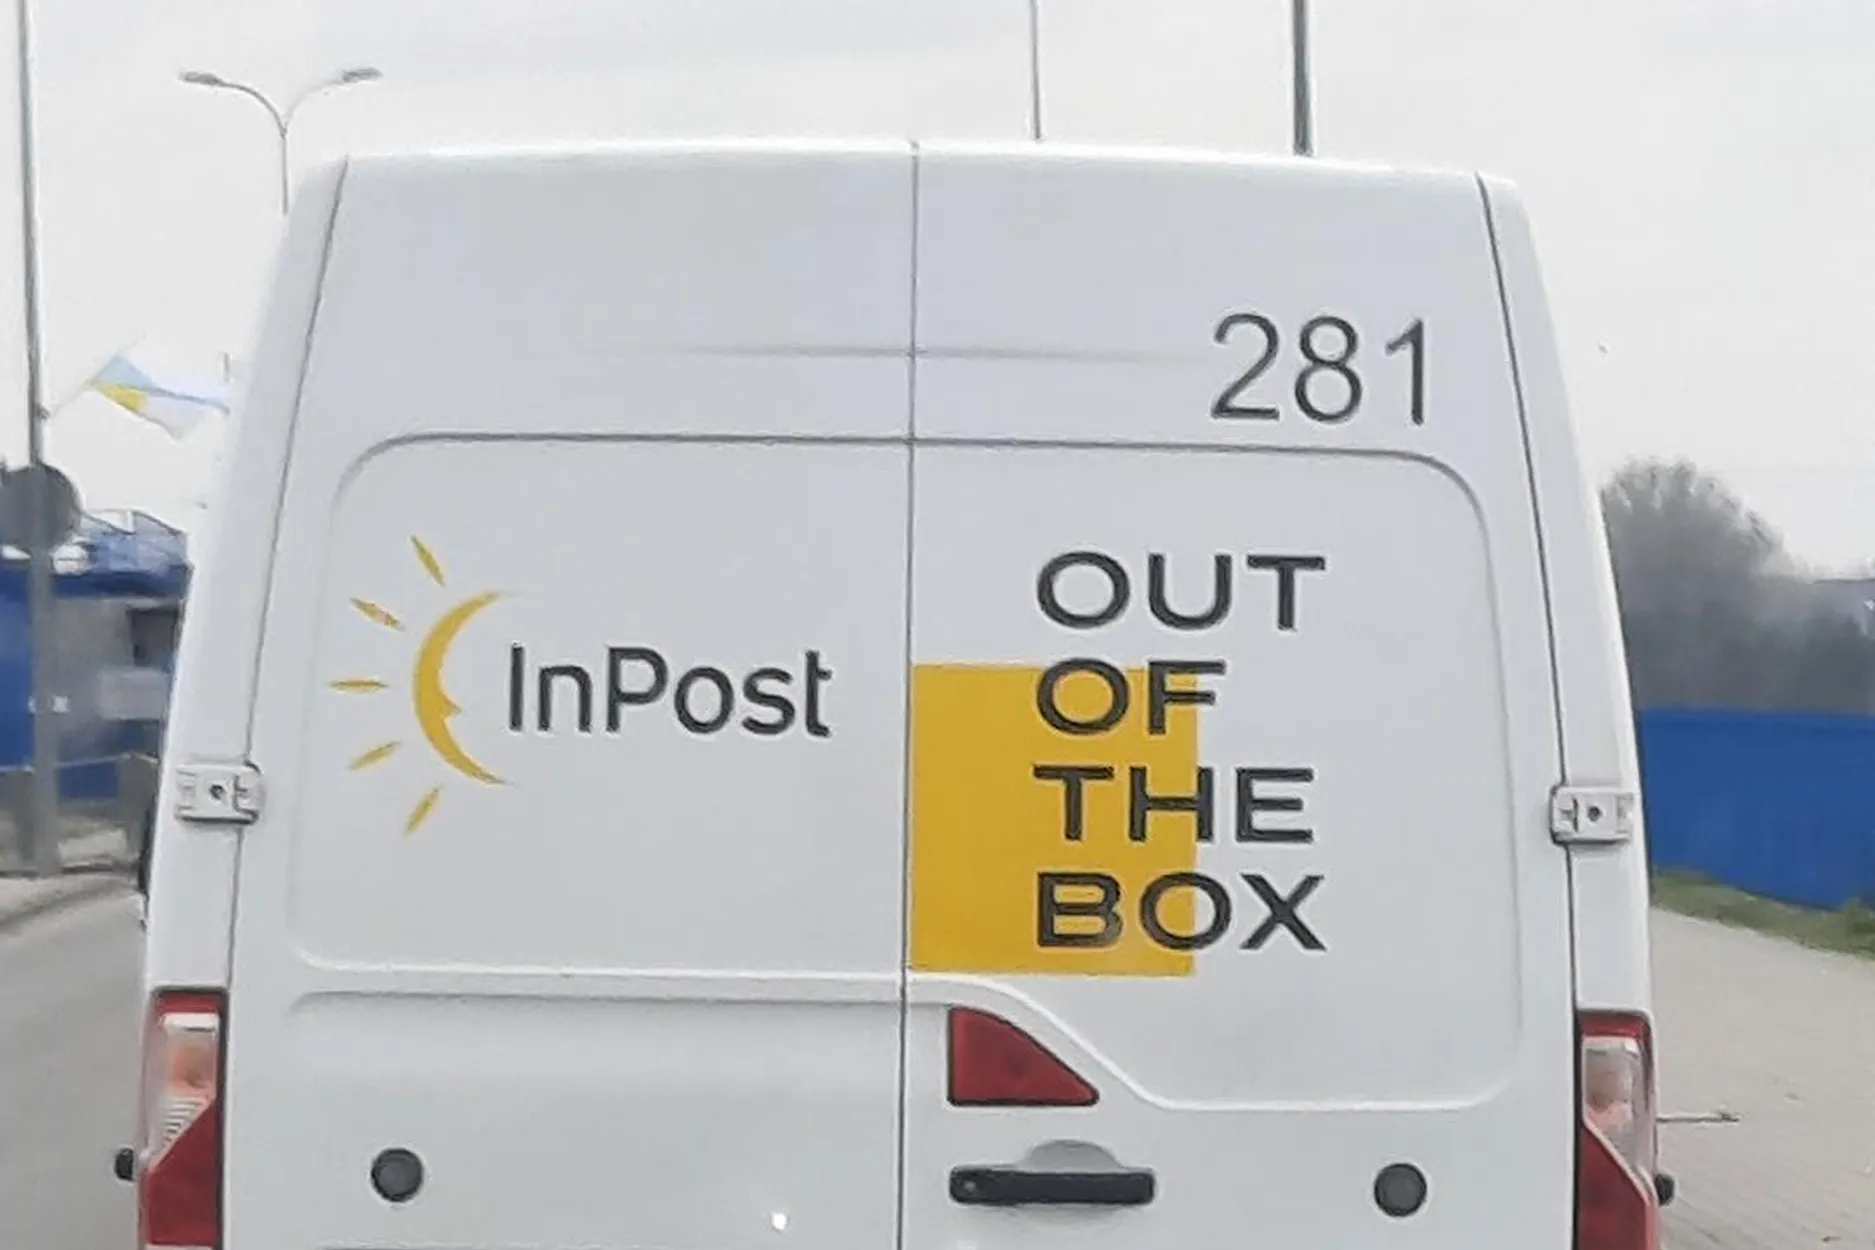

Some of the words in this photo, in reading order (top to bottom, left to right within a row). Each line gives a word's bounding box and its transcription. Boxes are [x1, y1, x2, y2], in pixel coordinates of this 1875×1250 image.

[1210, 313, 1424, 426] 281
[1036, 551, 1326, 631] OUT
[508, 643, 832, 738] InPost
[1036, 658, 1226, 736] OF
[1032, 765, 1314, 844] THE
[1036, 872, 1327, 952] BOX
